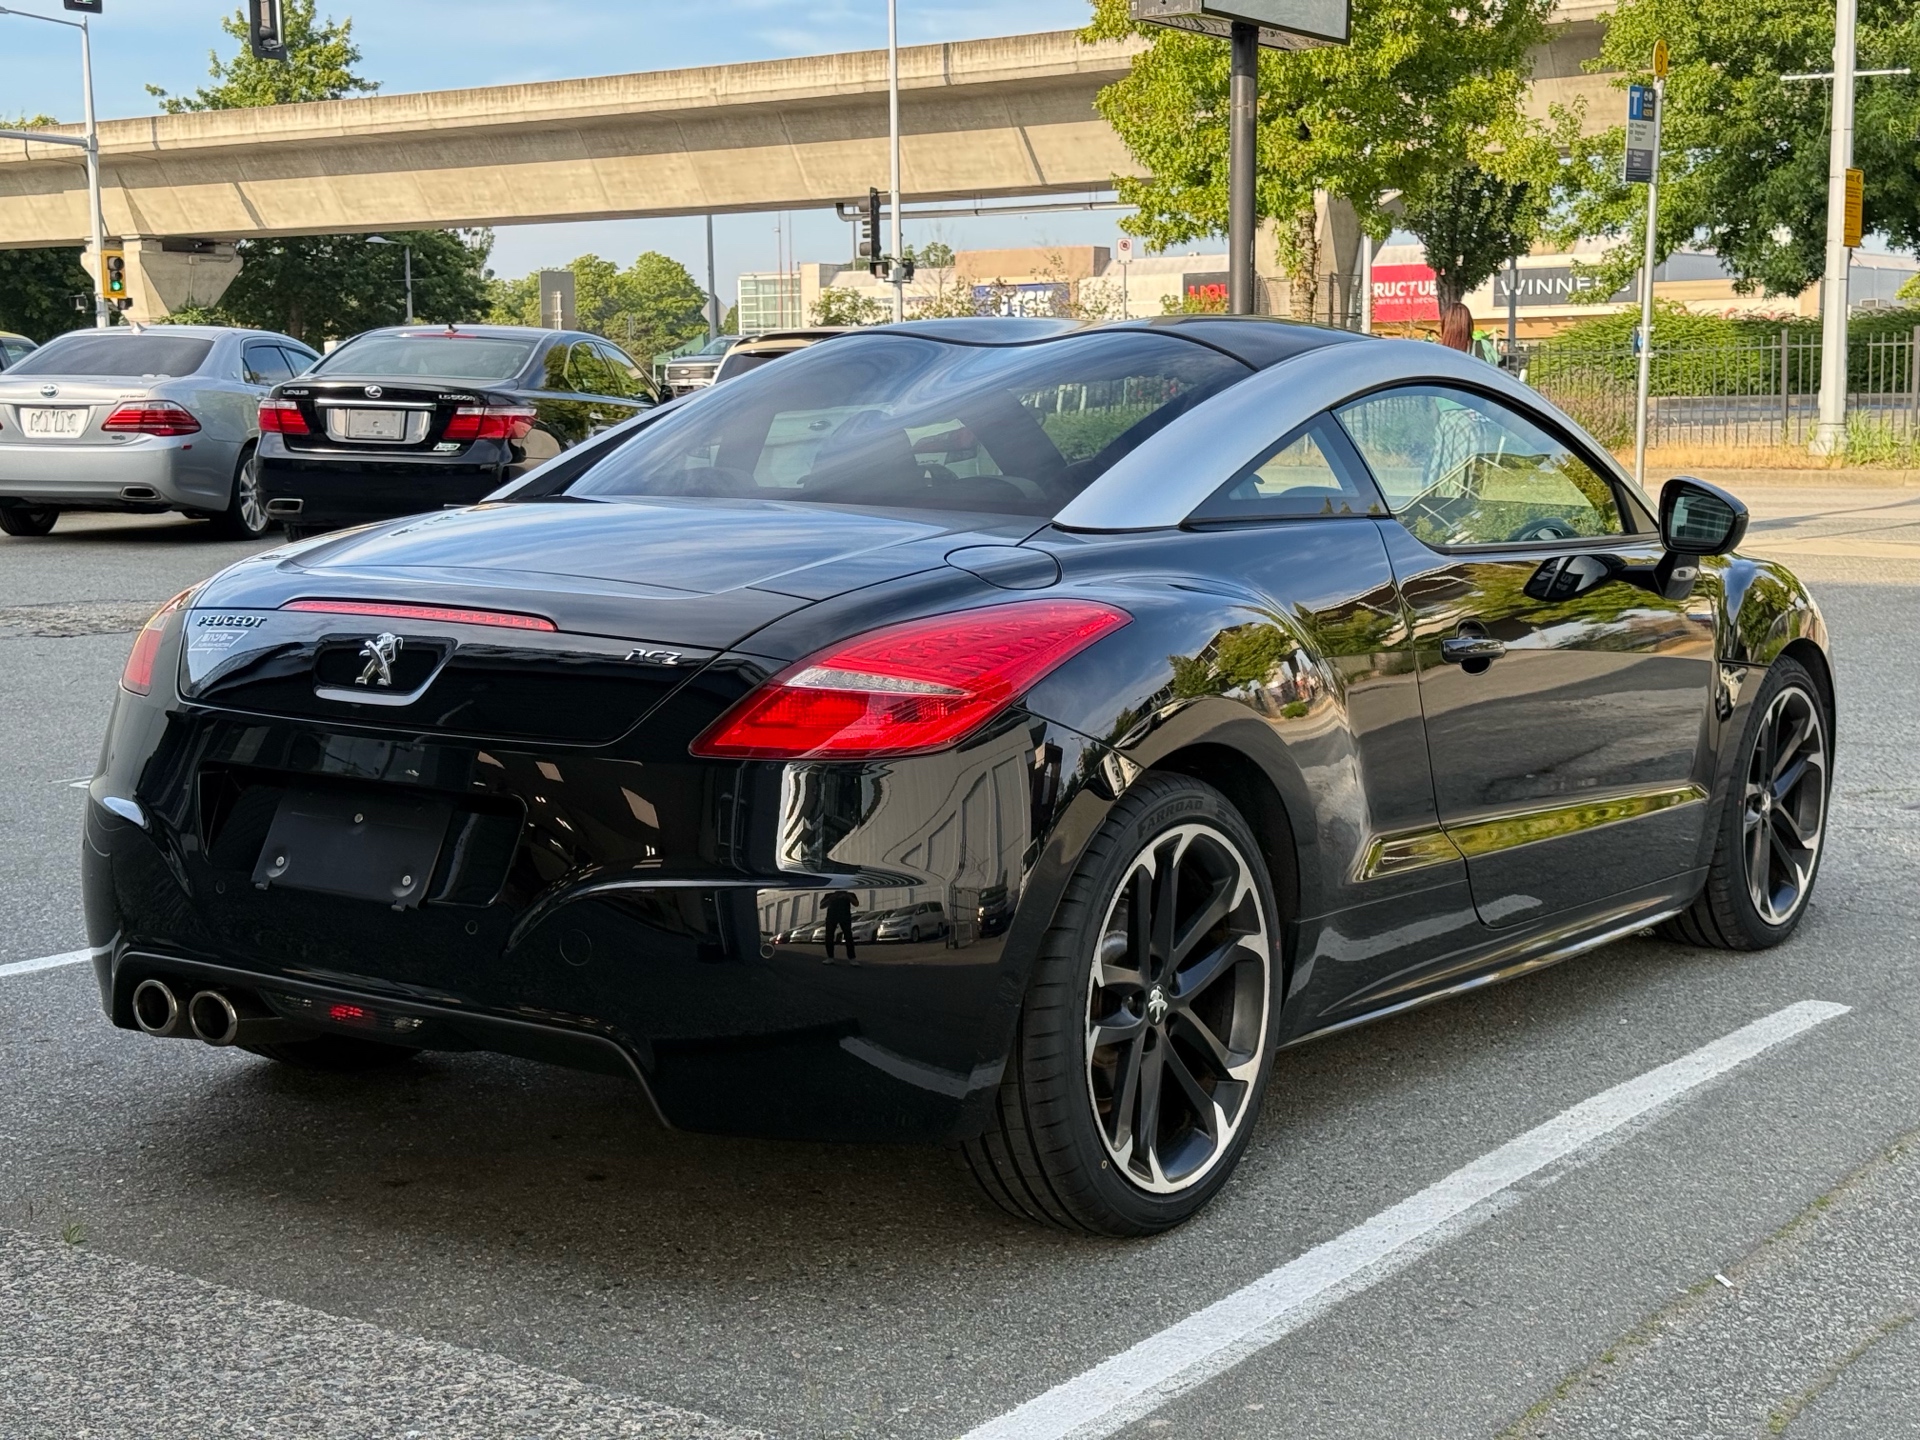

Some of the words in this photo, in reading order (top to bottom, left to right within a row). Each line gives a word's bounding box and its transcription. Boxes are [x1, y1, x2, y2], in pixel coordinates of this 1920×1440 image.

[1658, 54, 1664, 73] 3
[1631, 91, 1640, 115] T
[1500, 277, 1631, 296] WINNE
[197, 614, 267, 627] PEUGEOT
[625, 648, 682, 665] RCZ
[1137, 796, 1204, 840] FARROAD
